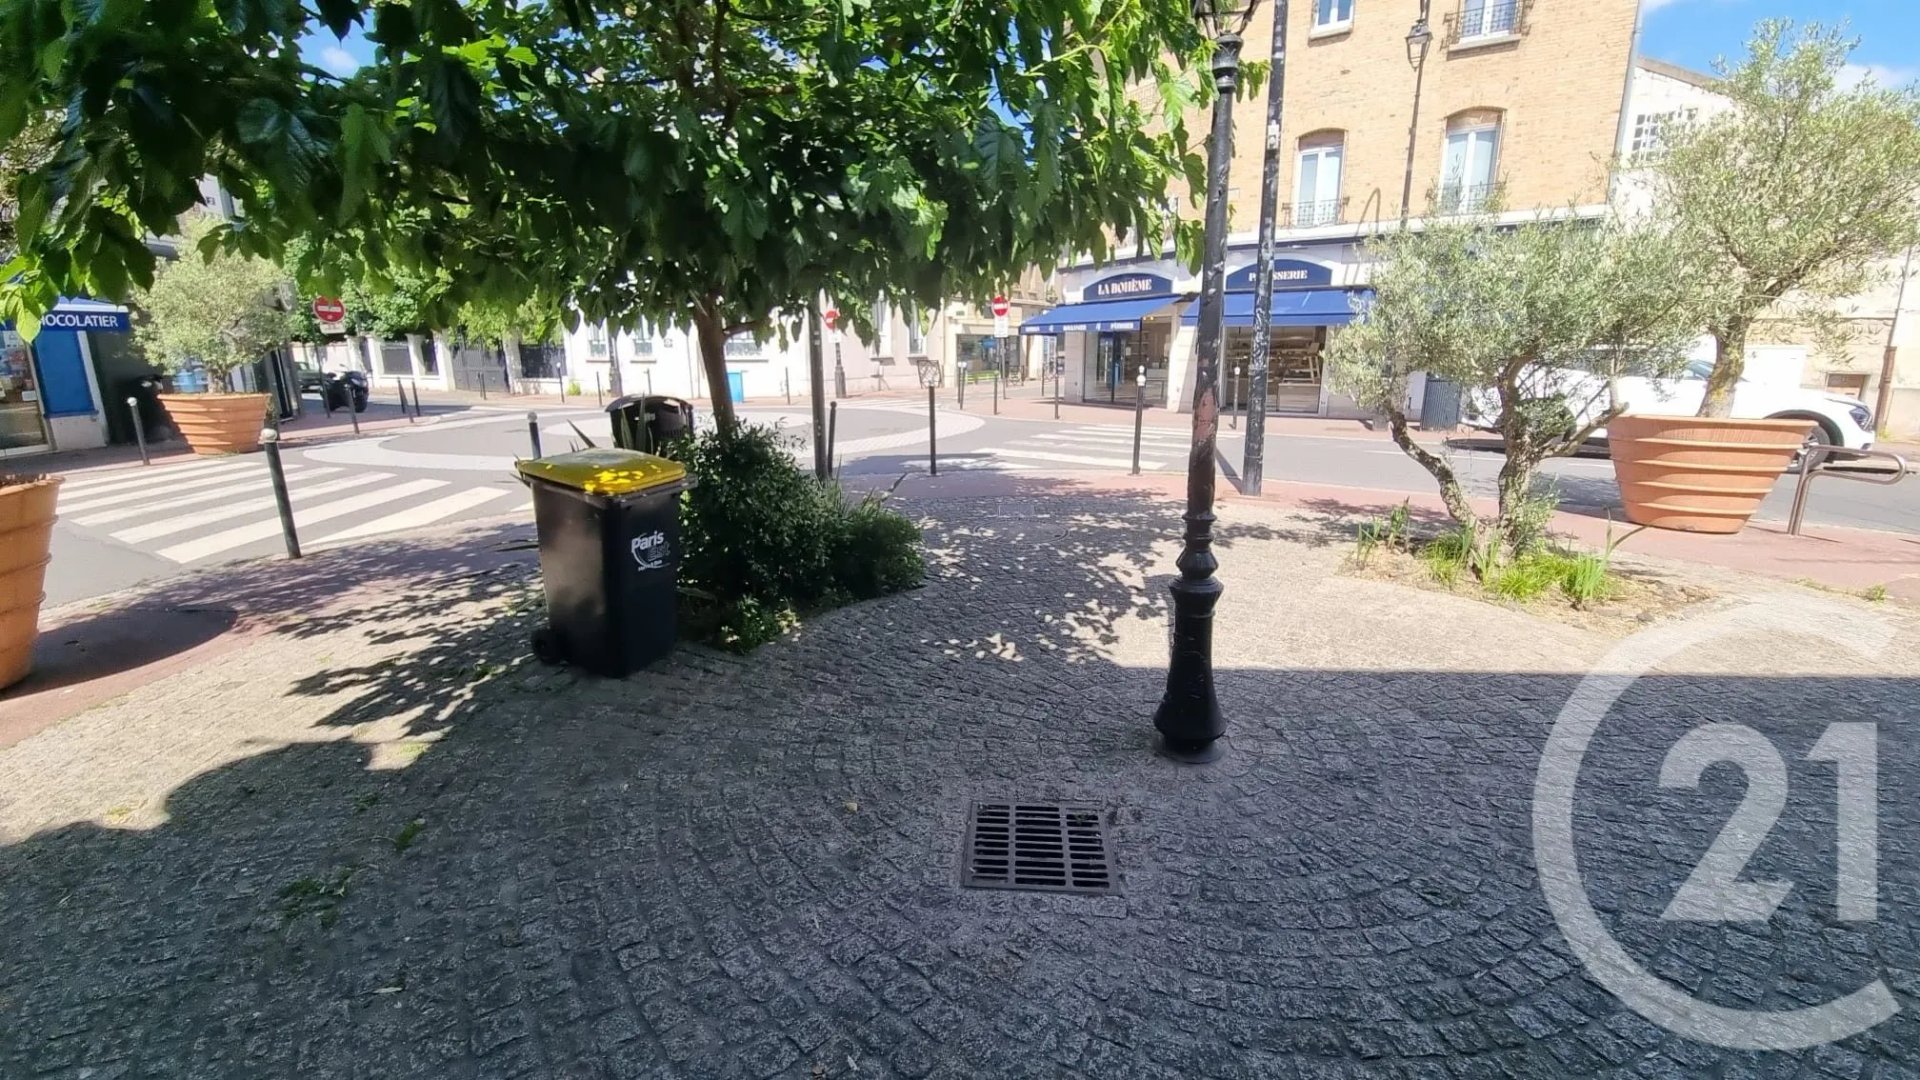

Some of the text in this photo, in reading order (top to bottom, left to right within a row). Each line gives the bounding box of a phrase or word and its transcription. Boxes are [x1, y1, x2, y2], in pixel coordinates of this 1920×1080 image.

[1248, 270, 1308, 282] PSSERIE
[1097, 278, 1153, 296] LA BOHÈME
[40, 313, 119, 328] HOCOLATIER
[631, 530, 664, 552] Paris
